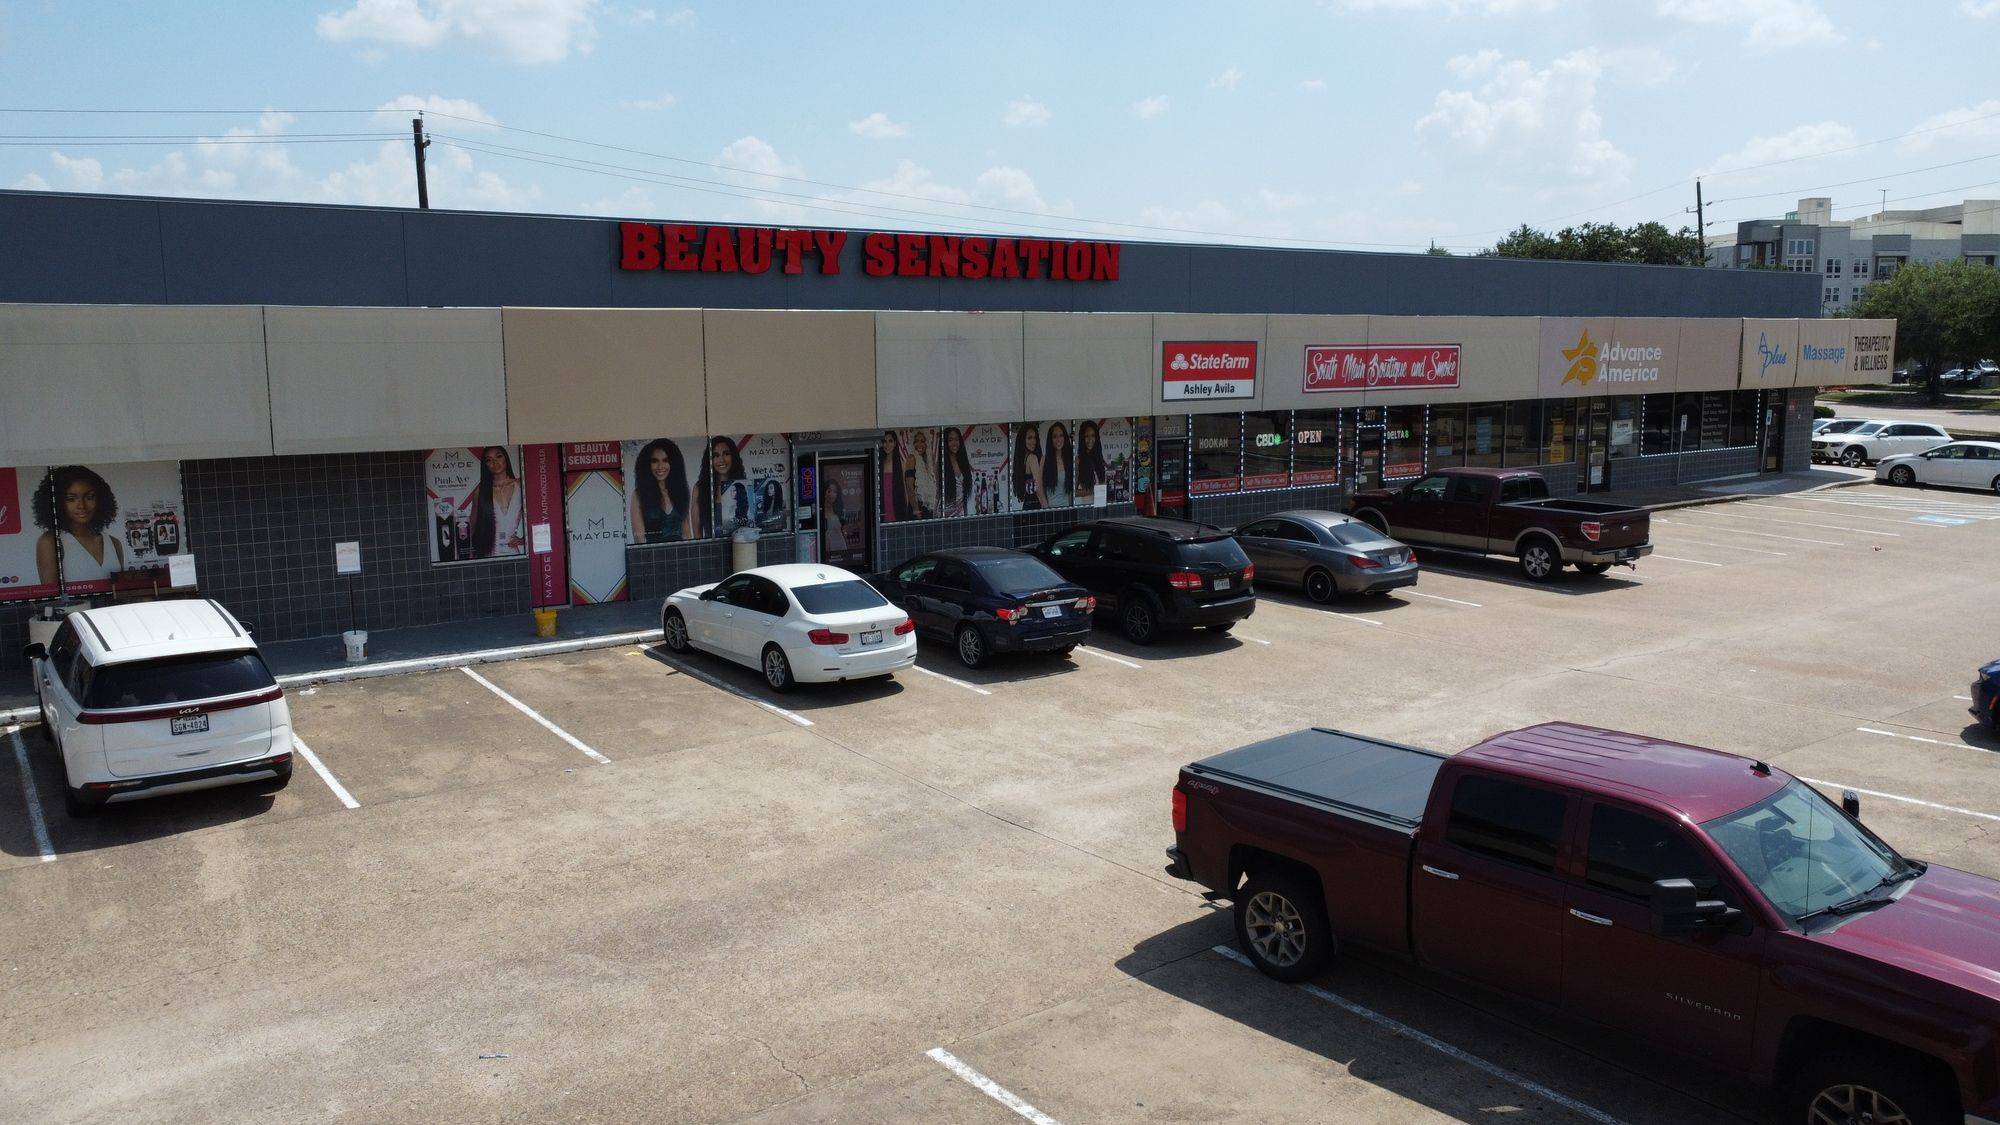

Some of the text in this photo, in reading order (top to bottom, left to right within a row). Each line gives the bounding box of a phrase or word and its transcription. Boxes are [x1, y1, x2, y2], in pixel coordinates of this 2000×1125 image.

[620, 222, 1121, 281] BEAUTY SENSATION
[1599, 340, 1662, 361] Advance
[1758, 332, 1769, 354] A
[1854, 335, 1891, 352] THERAPEUTIC
[1803, 344, 1845, 364] Massage
[1853, 354, 1888, 371] & WELLNESS
[1308, 351, 1456, 385] South Main Boutique and Smoke
[1598, 361, 1659, 382] America
[1183, 383, 1235, 396] Ashley Avila
[1200, 438, 1228, 449] HOOKAH
[1256, 434, 1274, 447] CBD
[1298, 430, 1322, 444] OPEN
[575, 443, 610, 453] BEAUTY
[749, 447, 785, 456] MAYDE
[432, 461, 474, 469] MAYDE
[539, 448, 547, 475] DEALER
[568, 454, 618, 465] SENSATION
[751, 467, 767, 475] Wet
[540, 477, 548, 515] AUTHORIZED
[573, 531, 621, 541] MAYDE
[543, 555, 552, 598] MAYDE
[1664, 992, 1743, 1021] SILVERADO
